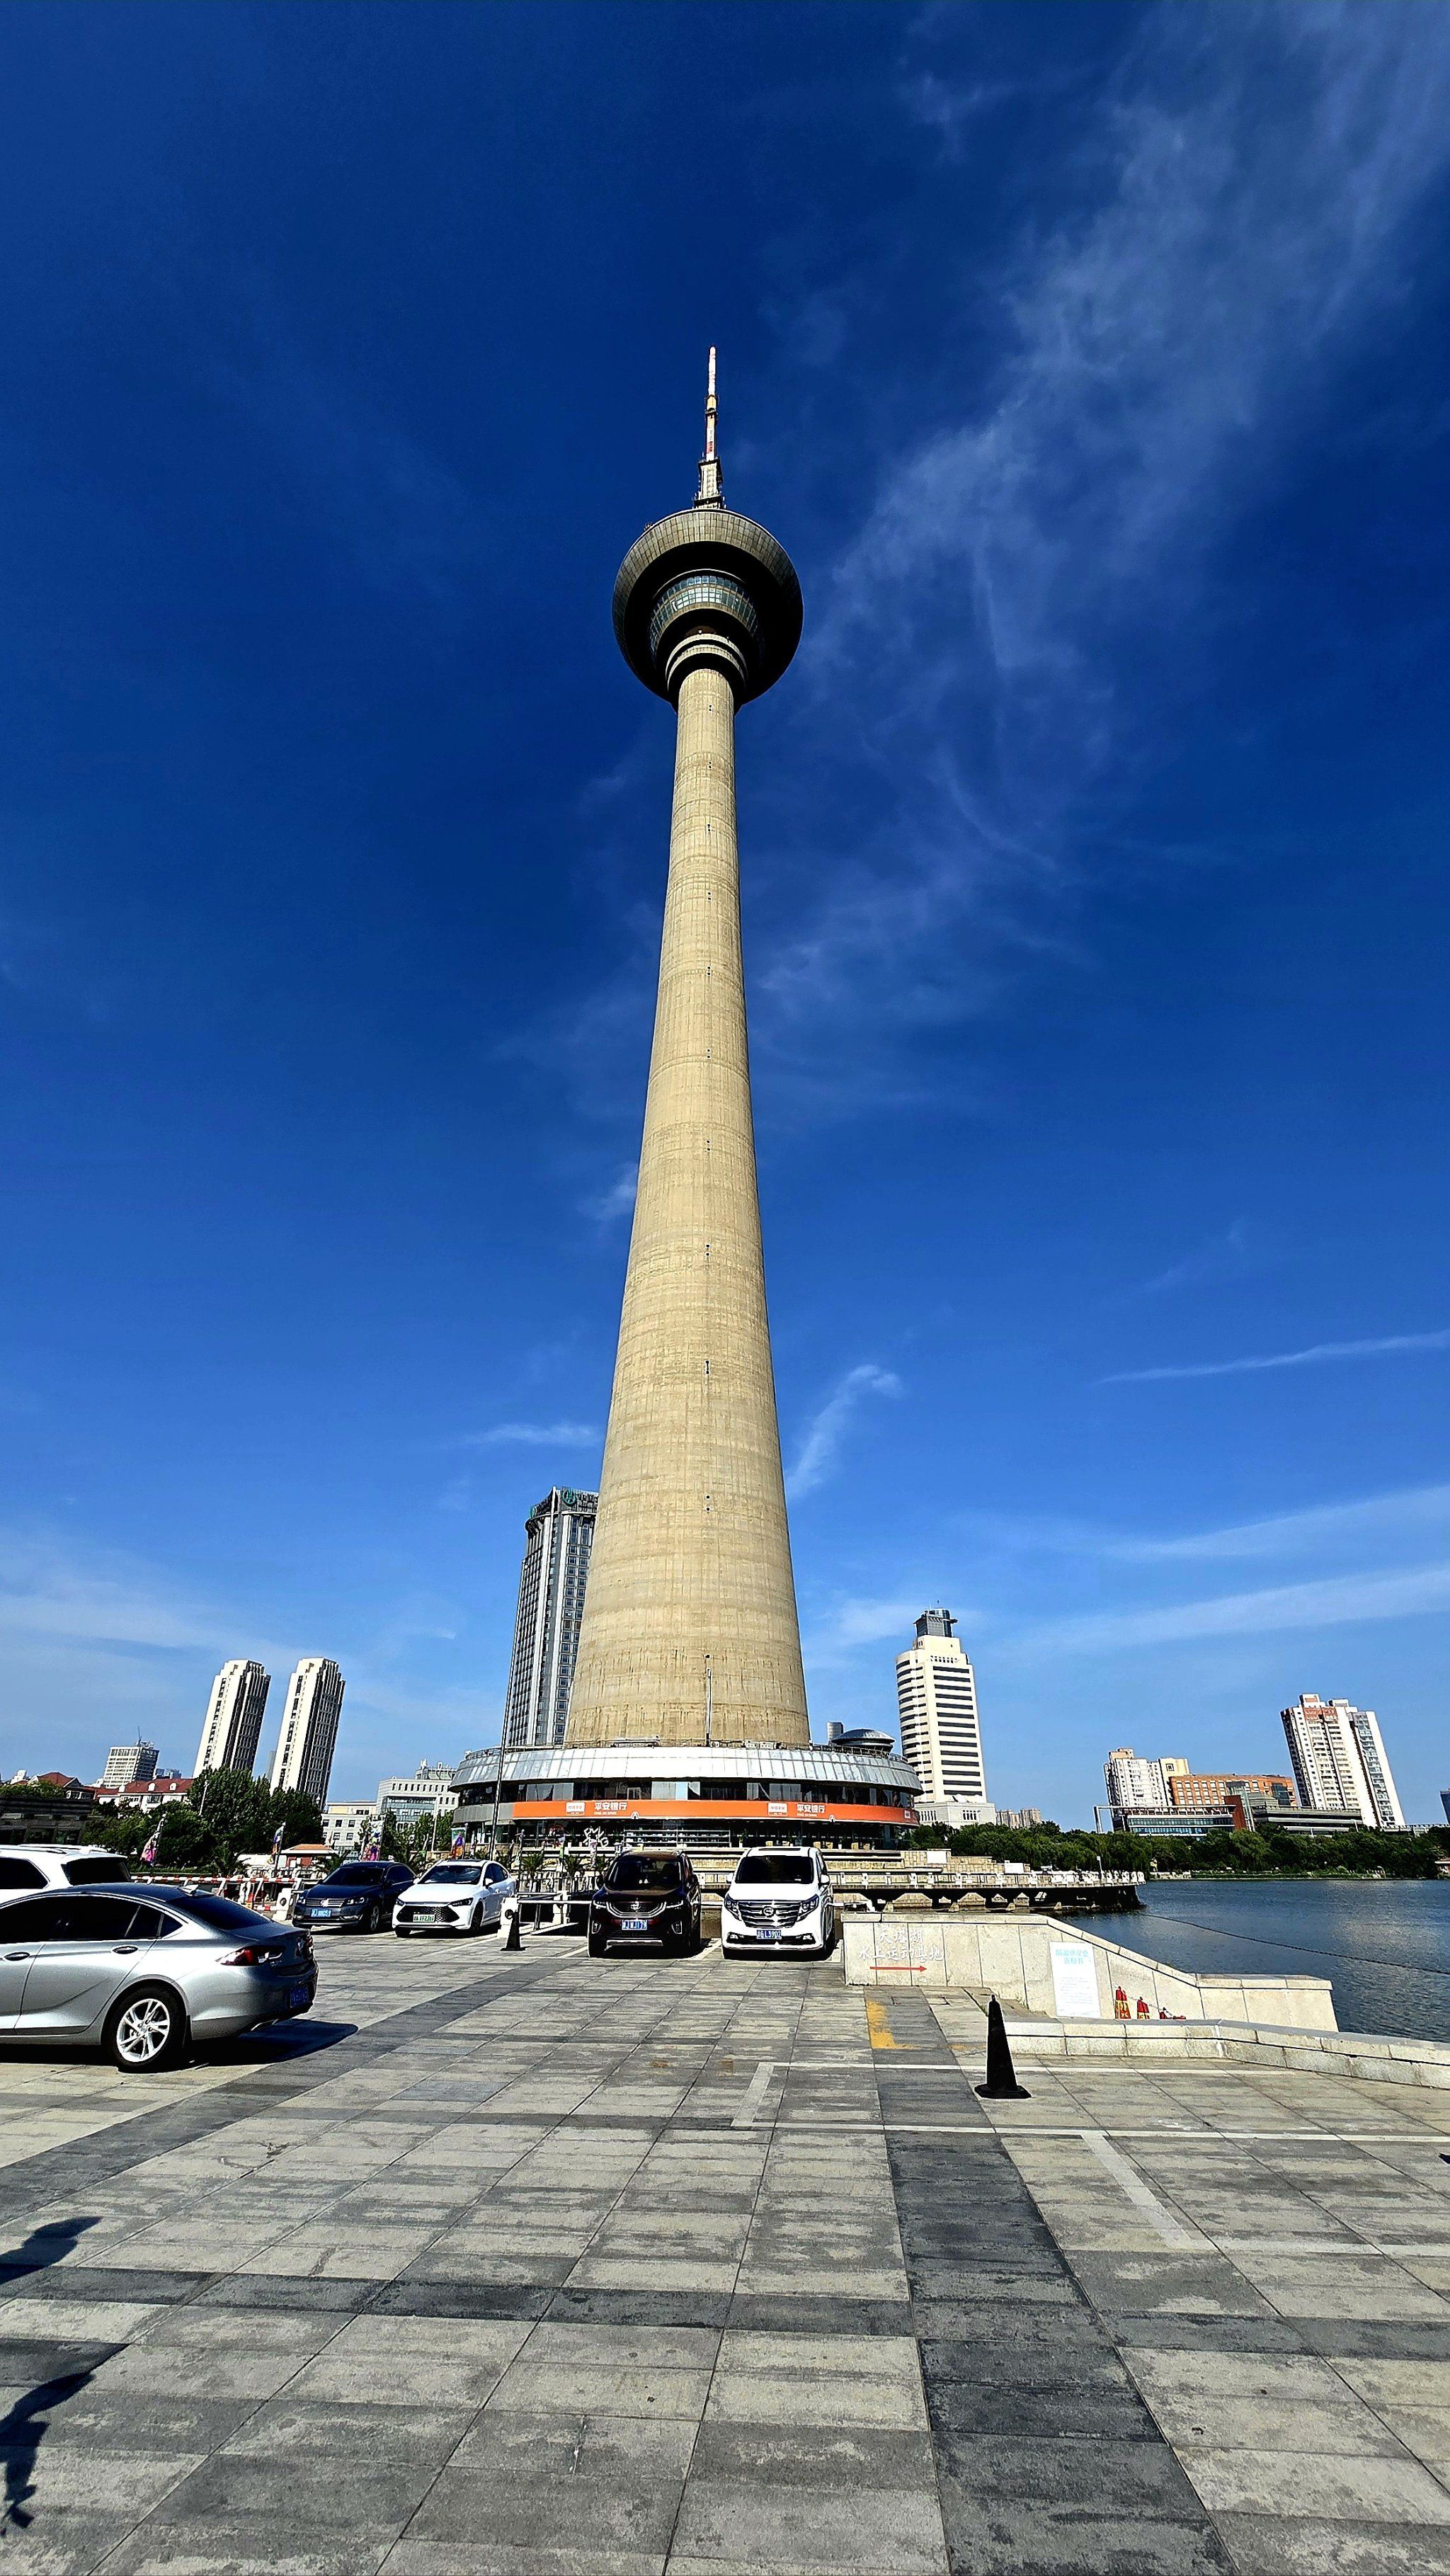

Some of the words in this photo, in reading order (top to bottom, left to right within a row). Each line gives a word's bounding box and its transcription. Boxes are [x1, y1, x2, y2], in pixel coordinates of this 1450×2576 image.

[595, 1801, 628, 1811] 平安银行
[797, 1803, 826, 1814] 平安银行
